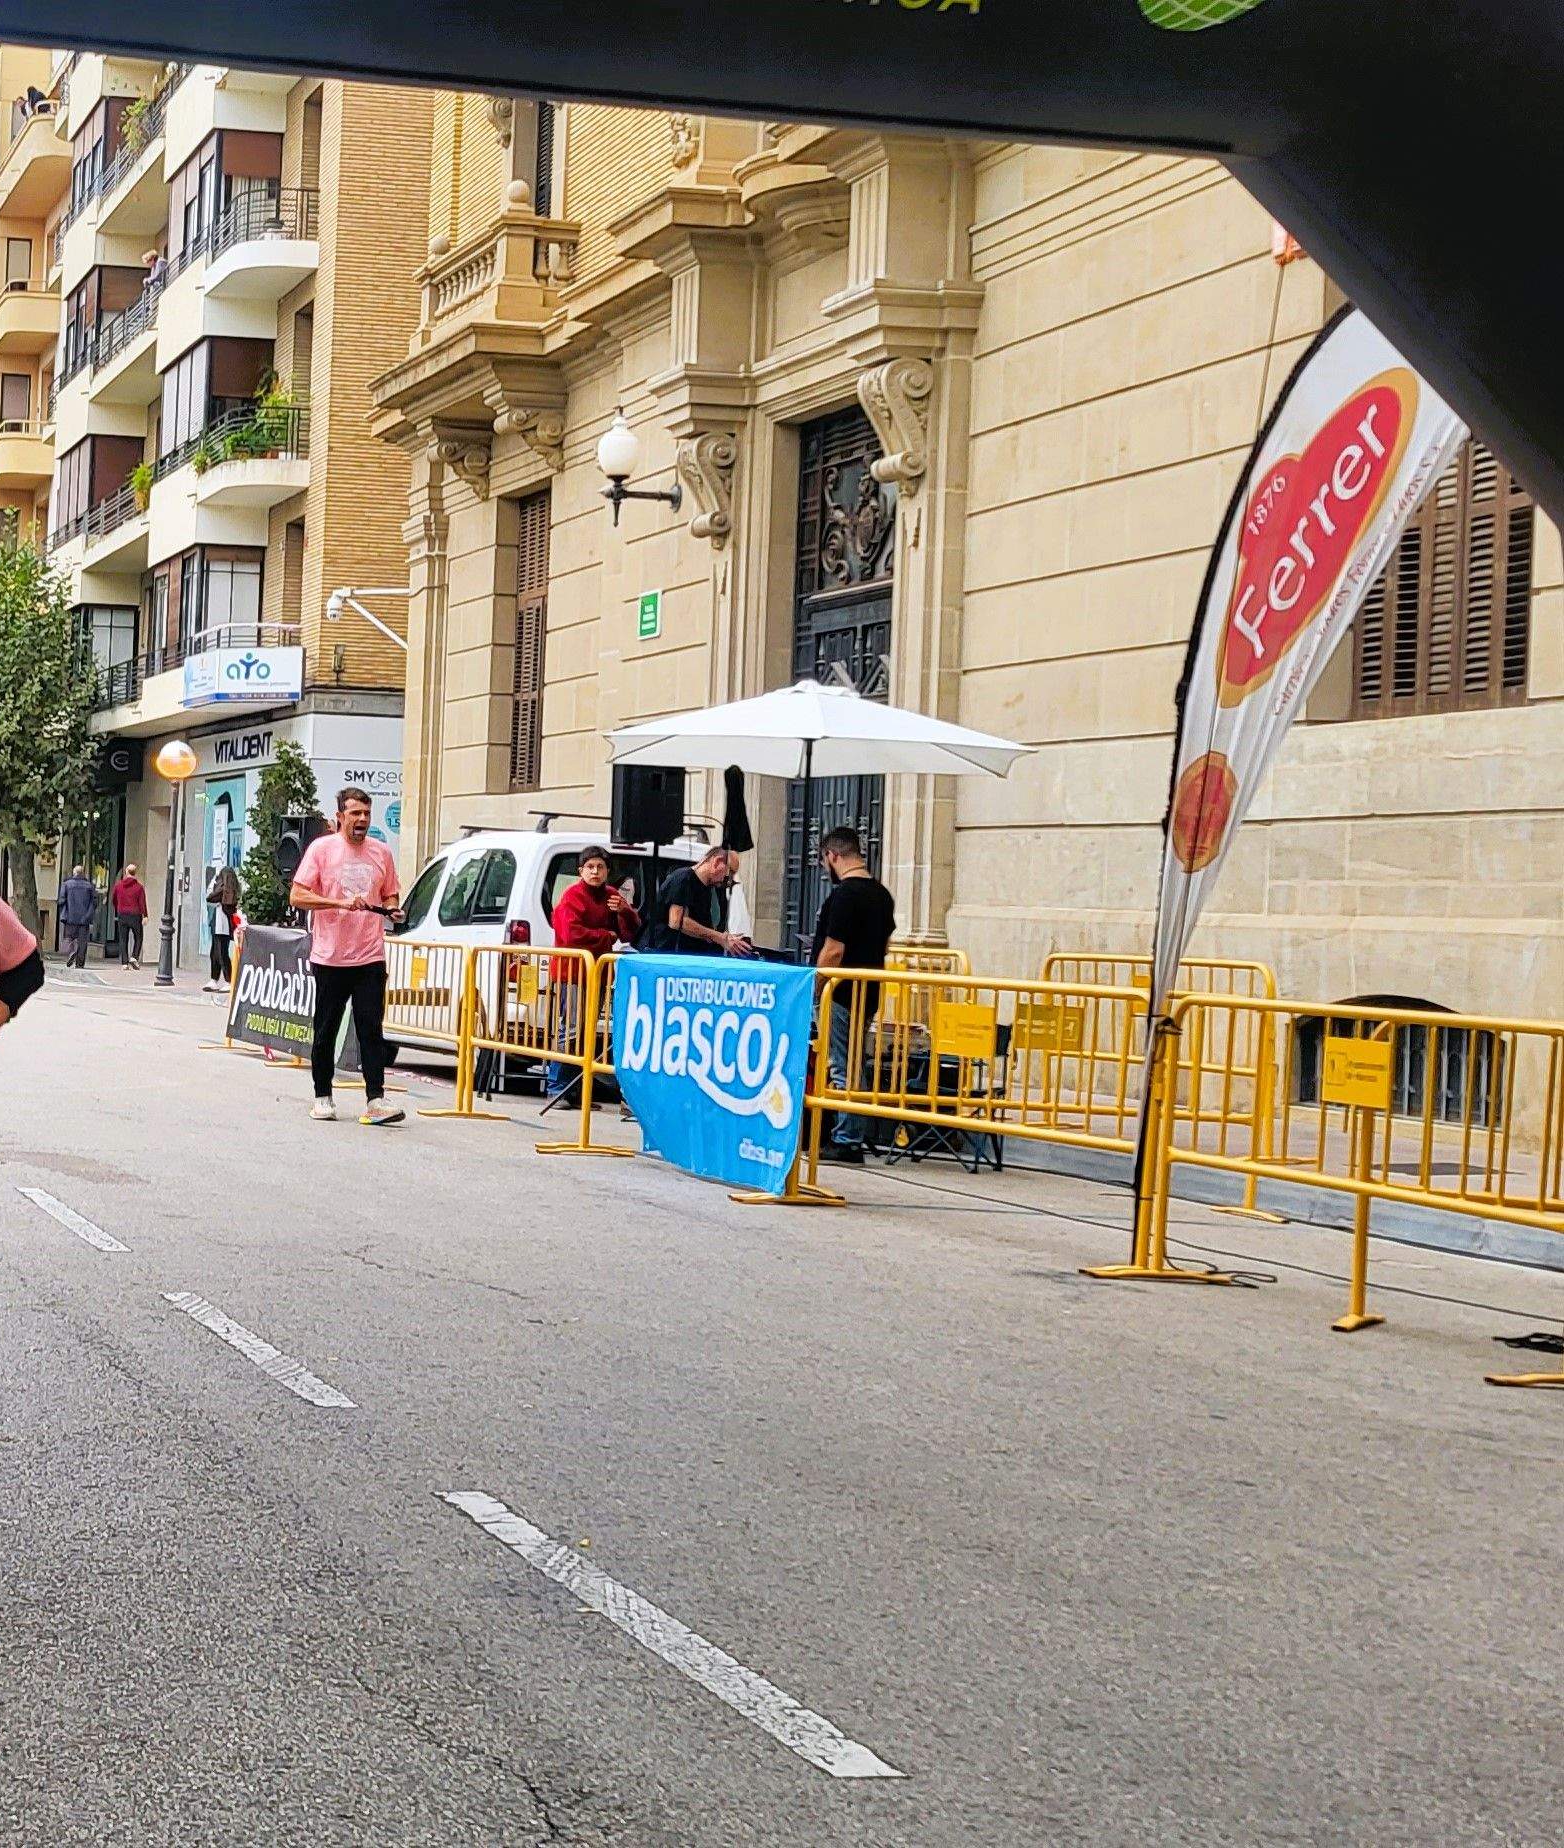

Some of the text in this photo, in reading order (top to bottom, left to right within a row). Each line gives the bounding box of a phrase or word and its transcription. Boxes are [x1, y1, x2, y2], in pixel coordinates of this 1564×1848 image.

[1233, 403, 1386, 660] Ferrer
[214, 731, 273, 764] VITALDENT
[665, 976, 776, 1010] DISTRIBUCIONES
[621, 975, 773, 1088] blasco
